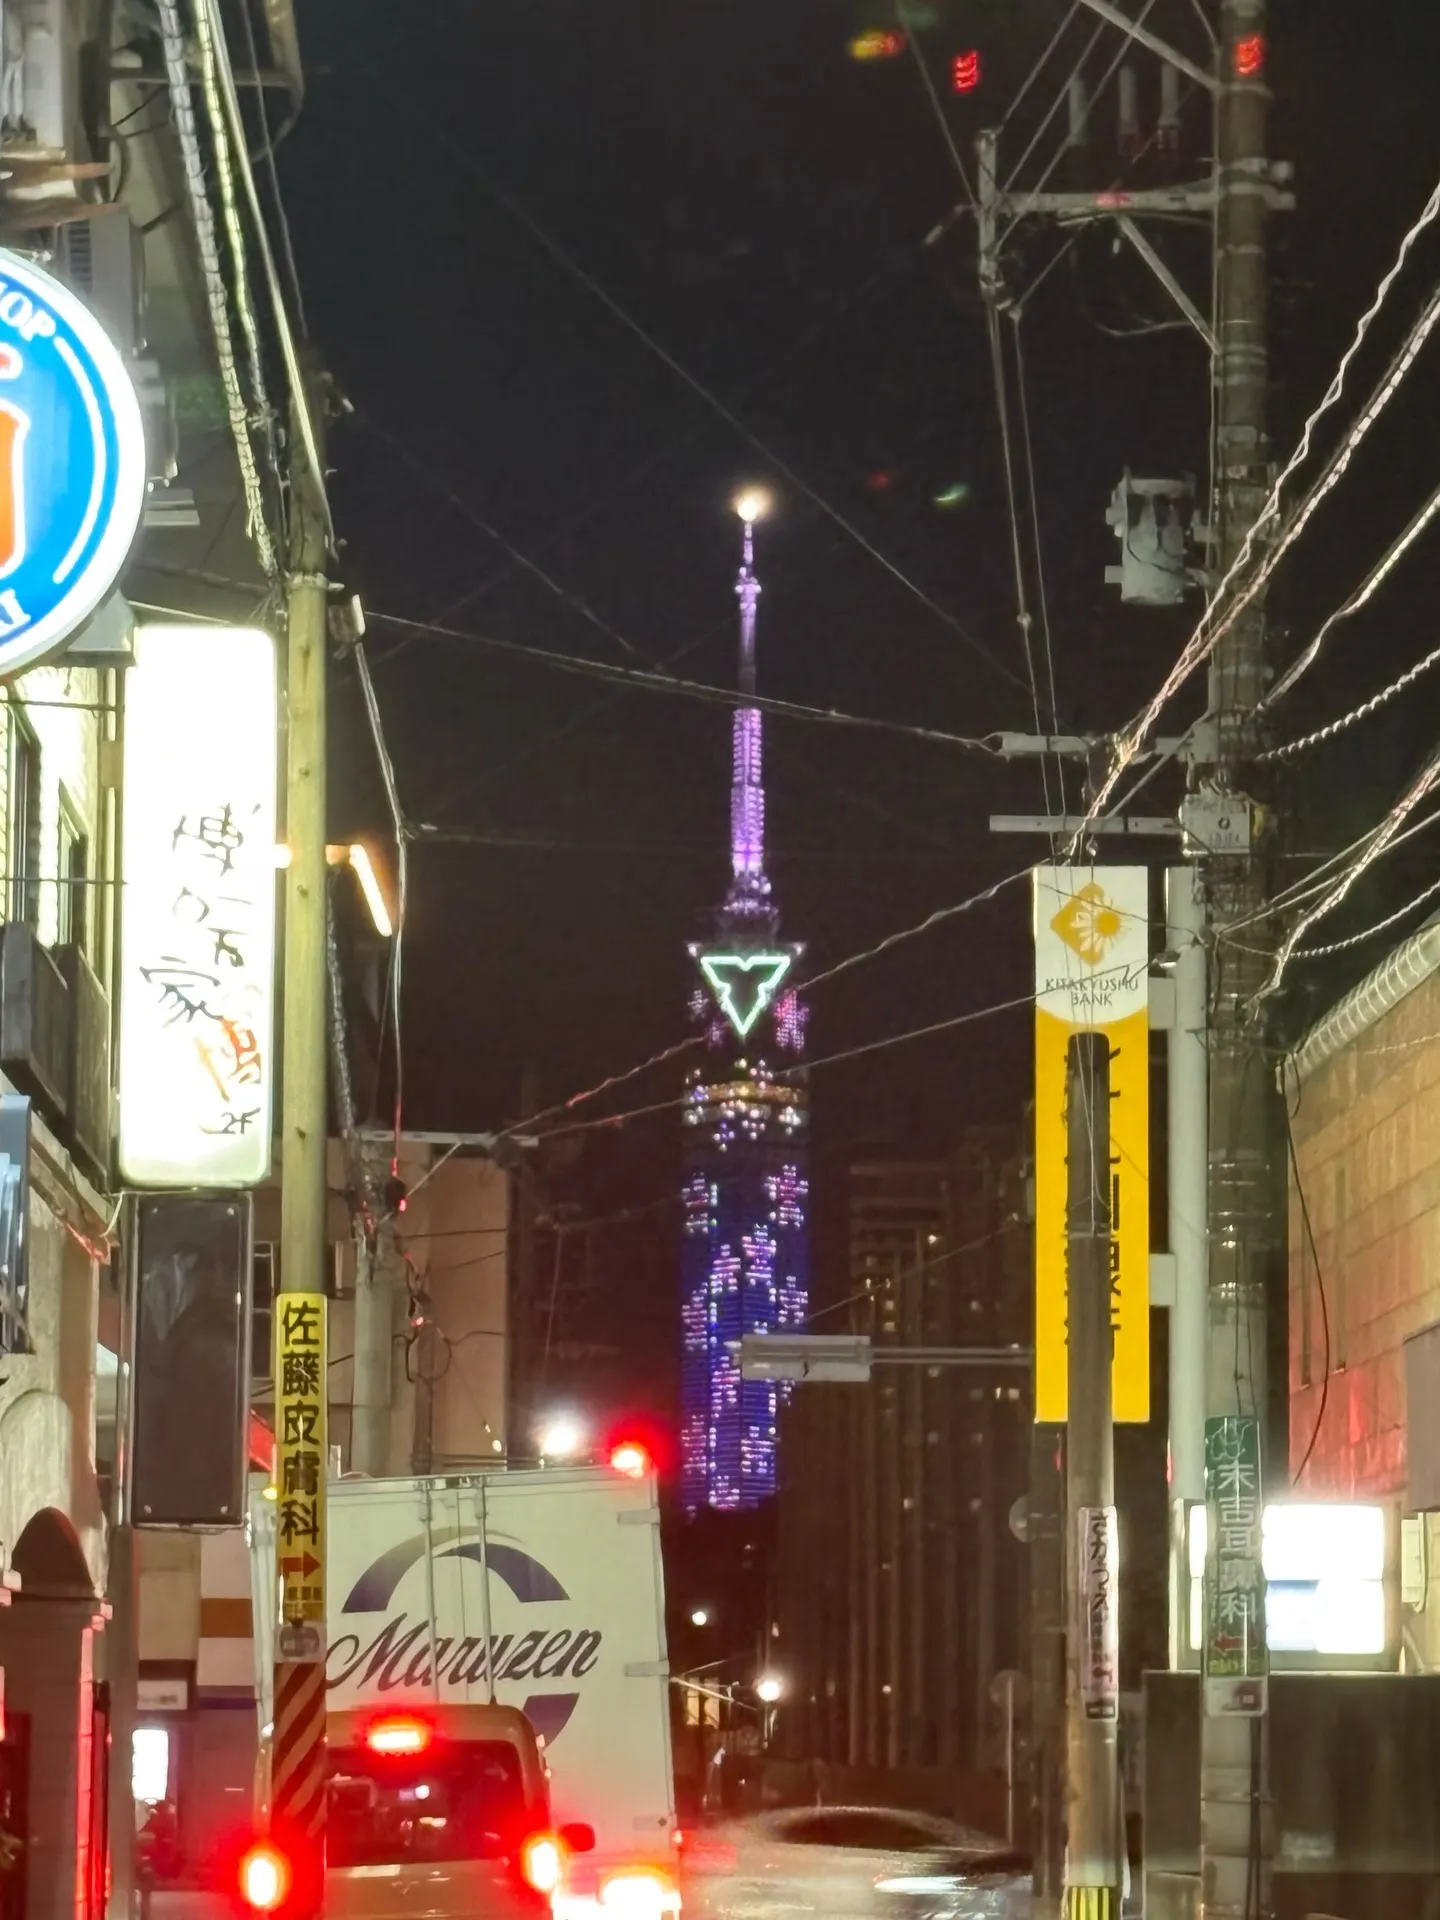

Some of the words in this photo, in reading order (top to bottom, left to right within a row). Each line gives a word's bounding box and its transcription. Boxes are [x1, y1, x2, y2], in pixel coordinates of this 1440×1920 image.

[0, 281, 56, 342] OP
[1045, 978, 1139, 992] KITAKYUSHU
[1070, 992, 1113, 1006] BANK
[282, 1300, 320, 1546] 佐藤皮膚科
[325, 1611, 602, 1692] Maruzen
